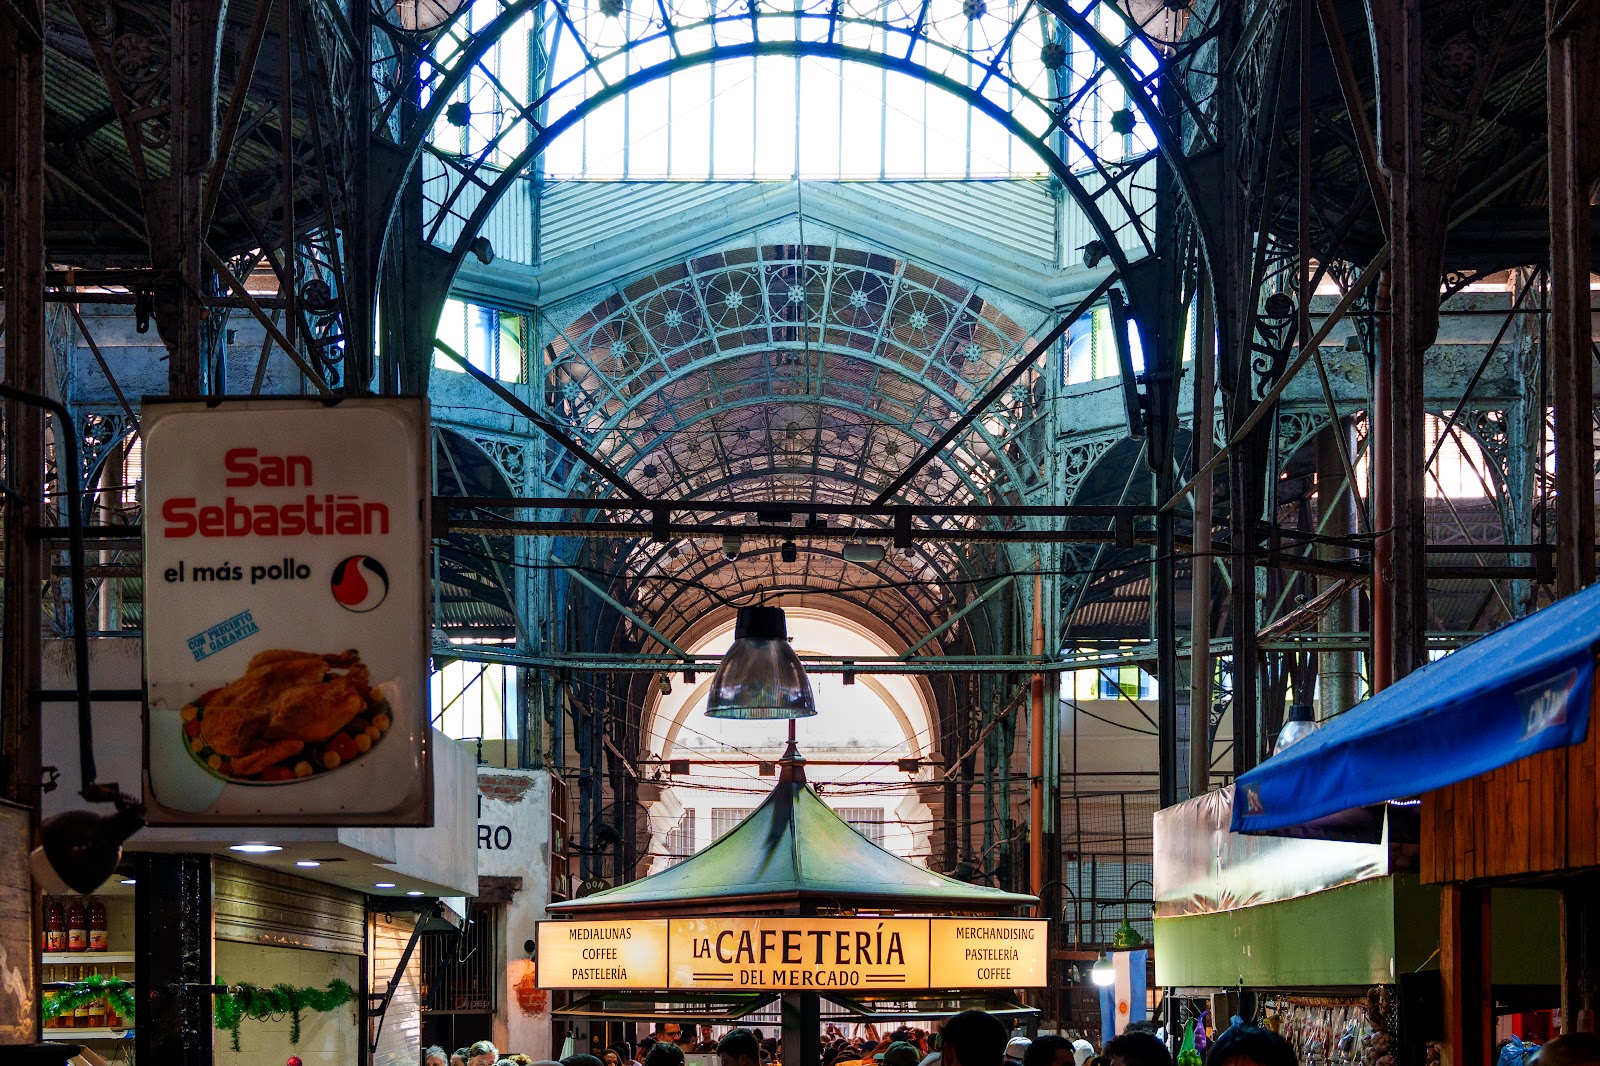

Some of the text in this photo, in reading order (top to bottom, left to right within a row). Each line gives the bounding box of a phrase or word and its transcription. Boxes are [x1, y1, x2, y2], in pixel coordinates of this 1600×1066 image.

[225, 448, 313, 487] San
[164, 558, 311, 584] el más pollo
[188, 612, 253, 650] CON PRECINTO
[192, 622, 259, 660] DE GARANTIA
[569, 927, 632, 940] MEDIALUNAS
[956, 927, 1035, 940] MERCHANDISING
[693, 923, 906, 965] LA CAFETERÍA
[582, 948, 617, 960] COFFEE
[965, 946, 1019, 961] PASTELERÍA
[572, 965, 627, 980] PASTELERÍA
[740, 970, 860, 986] DEL MERCADO
[977, 967, 1011, 980] COFFEE
